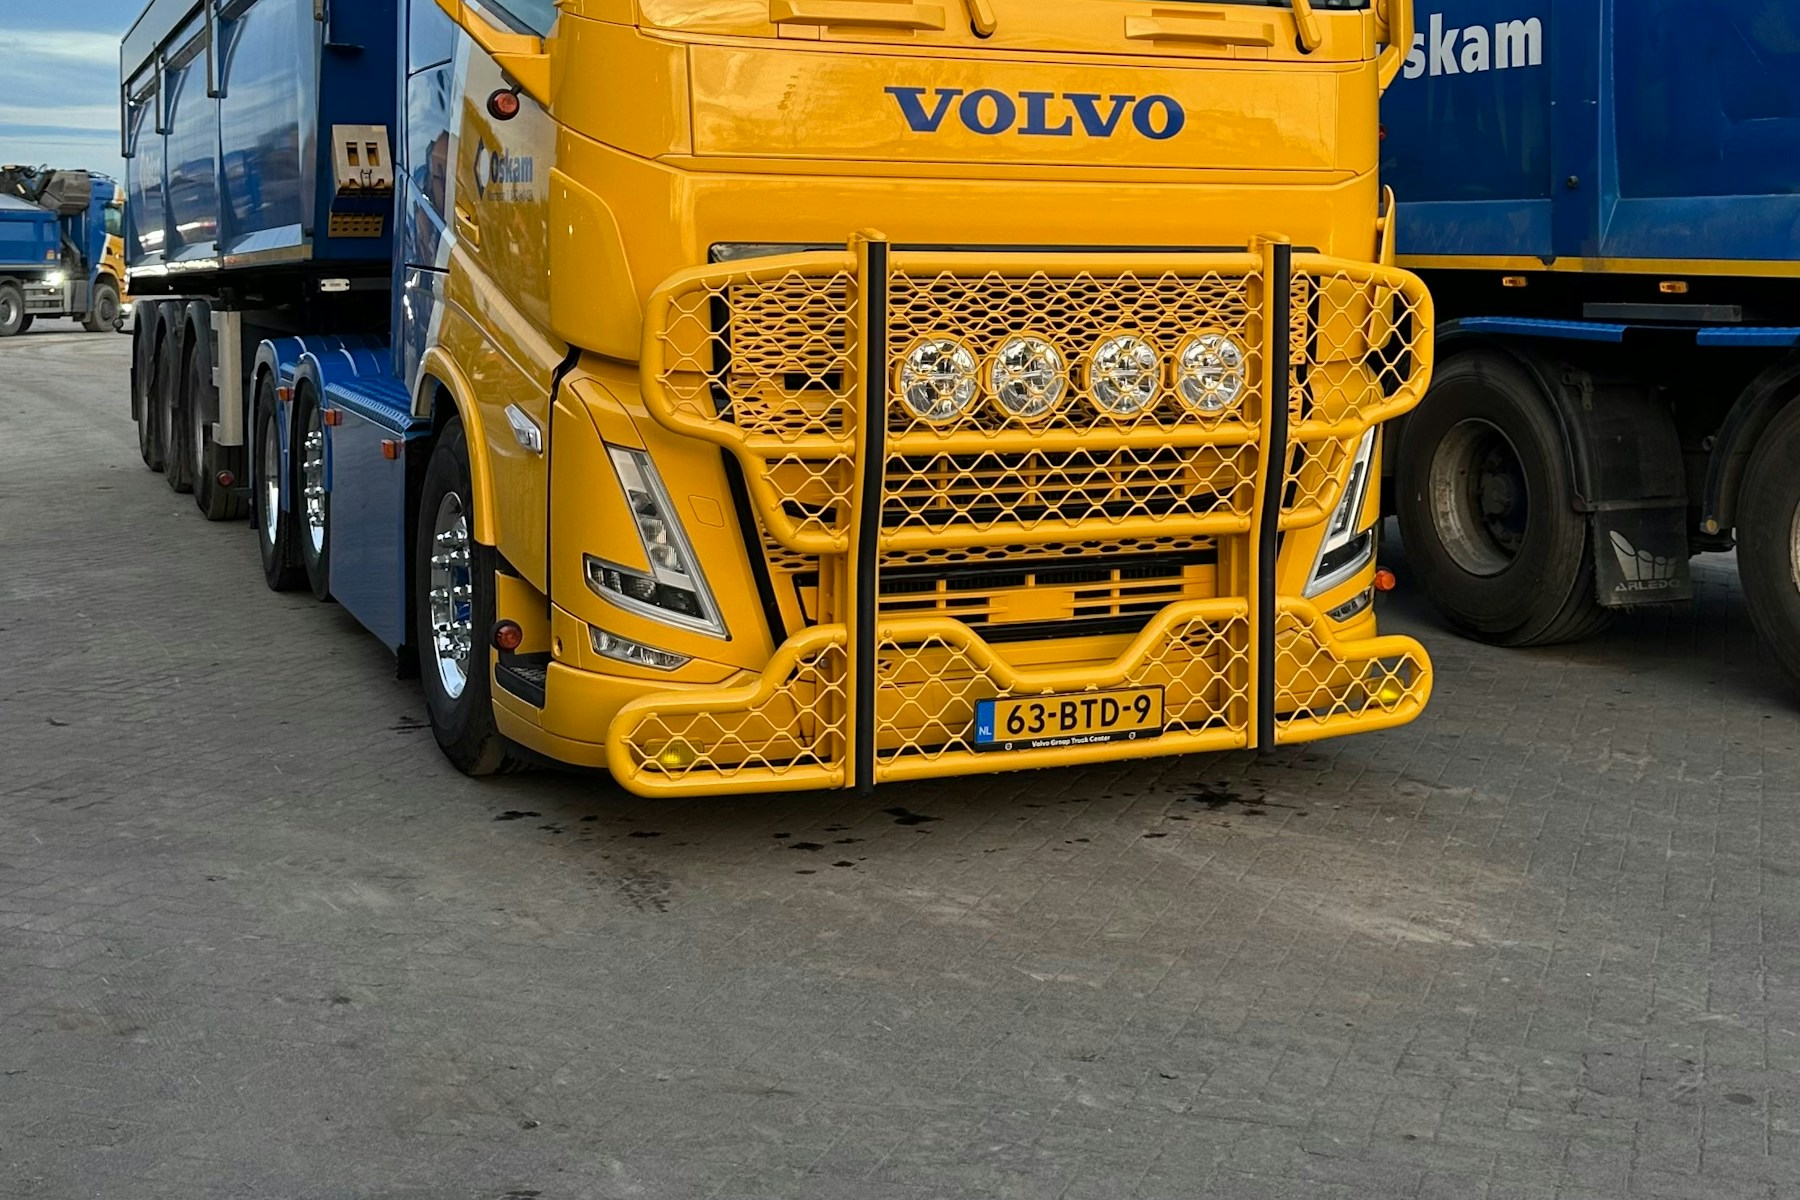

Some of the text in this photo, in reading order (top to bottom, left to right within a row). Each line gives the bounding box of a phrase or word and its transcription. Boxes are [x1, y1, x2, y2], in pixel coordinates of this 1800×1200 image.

[1376, 12, 1543, 80] skam
[884, 86, 1186, 140] VOLVO
[491, 148, 533, 184] Oskam
[978, 726, 992, 736] NL
[1006, 694, 1152, 735] 63-BTD-9
[1031, 740, 1050, 748] Volvo
[1050, 738, 1071, 747] Group
[1089, 735, 1111, 743] Center
